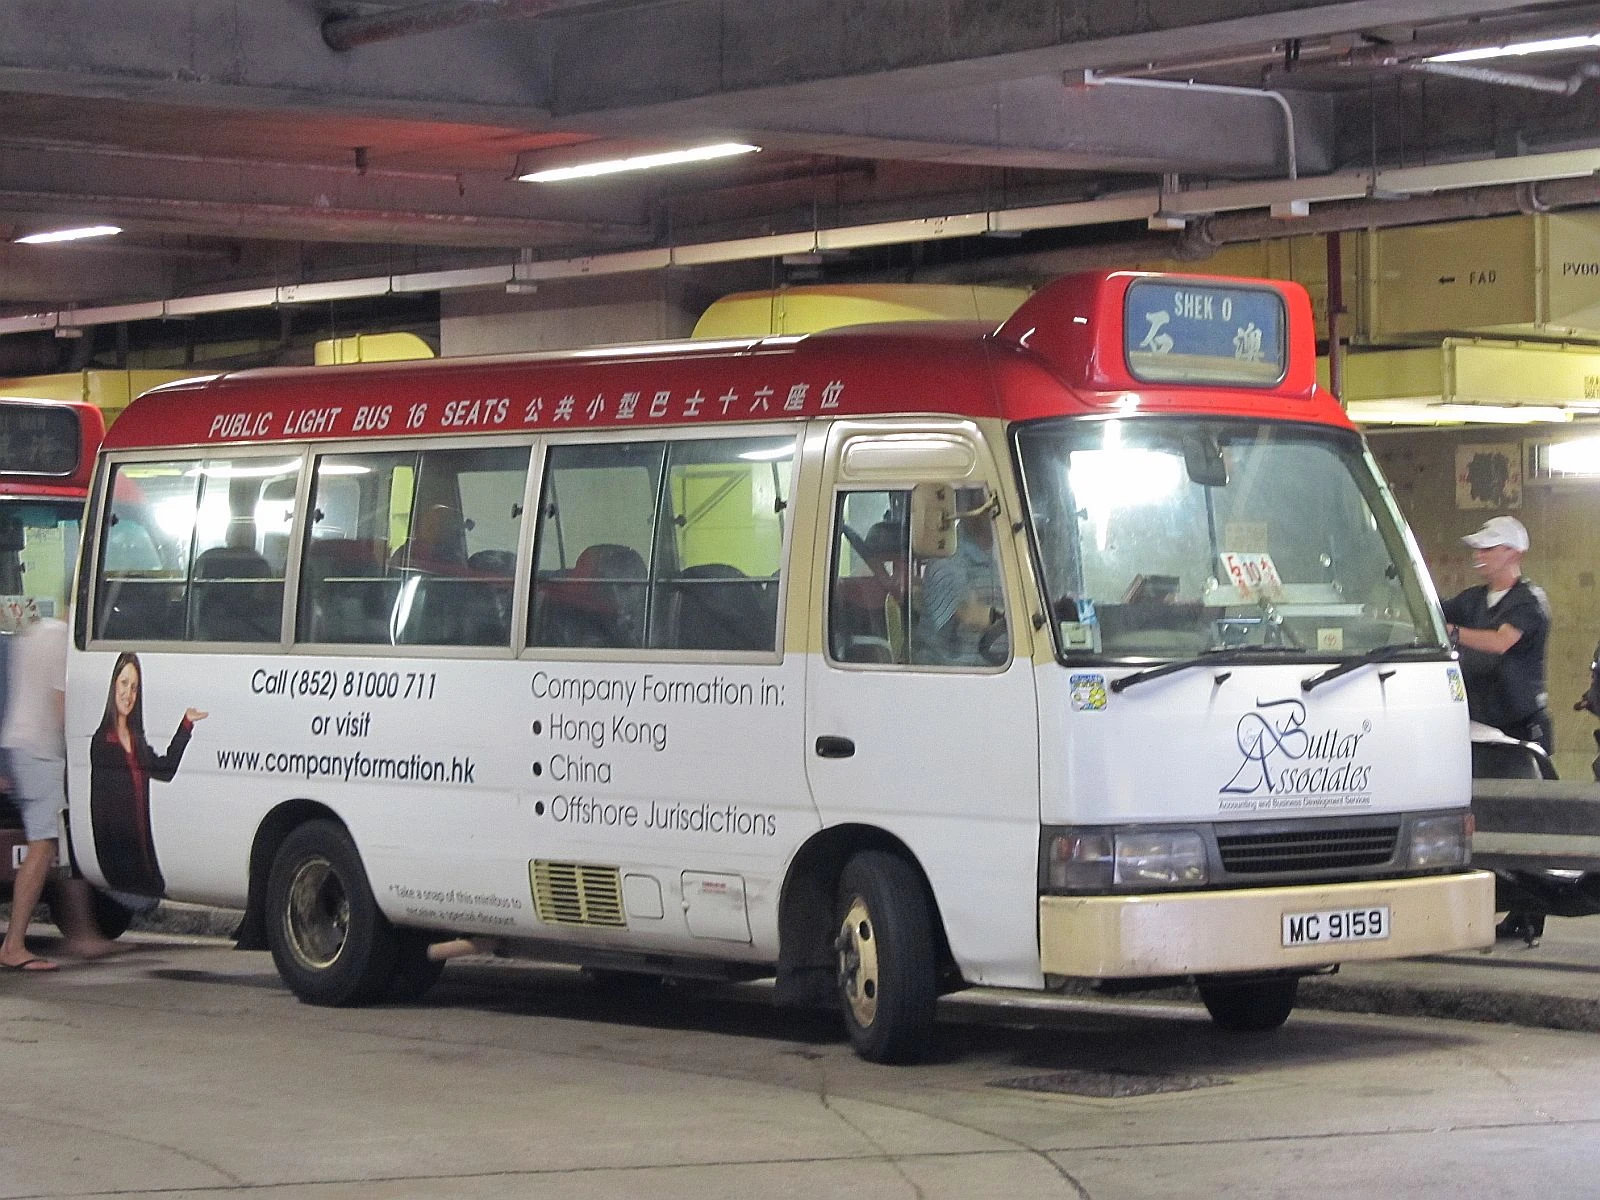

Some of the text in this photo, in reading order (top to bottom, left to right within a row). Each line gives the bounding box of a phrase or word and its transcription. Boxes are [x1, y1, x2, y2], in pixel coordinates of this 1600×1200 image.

[1174, 291, 1214, 320] SHEK
[208, 398, 510, 438] PUBLIC LIGHT BUS 16 SEATS
[251, 668, 436, 700] Call (852) 81000 711
[531, 671, 786, 708] Company Formation in:
[311, 711, 371, 738] or visit
[550, 713, 667, 751] Hong Kong
[216, 750, 476, 783] www.companyformation.hk
[549, 754, 611, 784] China
[1219, 727, 1371, 794] Associates
[551, 795, 777, 836] Offshore Jurisdictions
[1290, 911, 1382, 942] MC 9159
